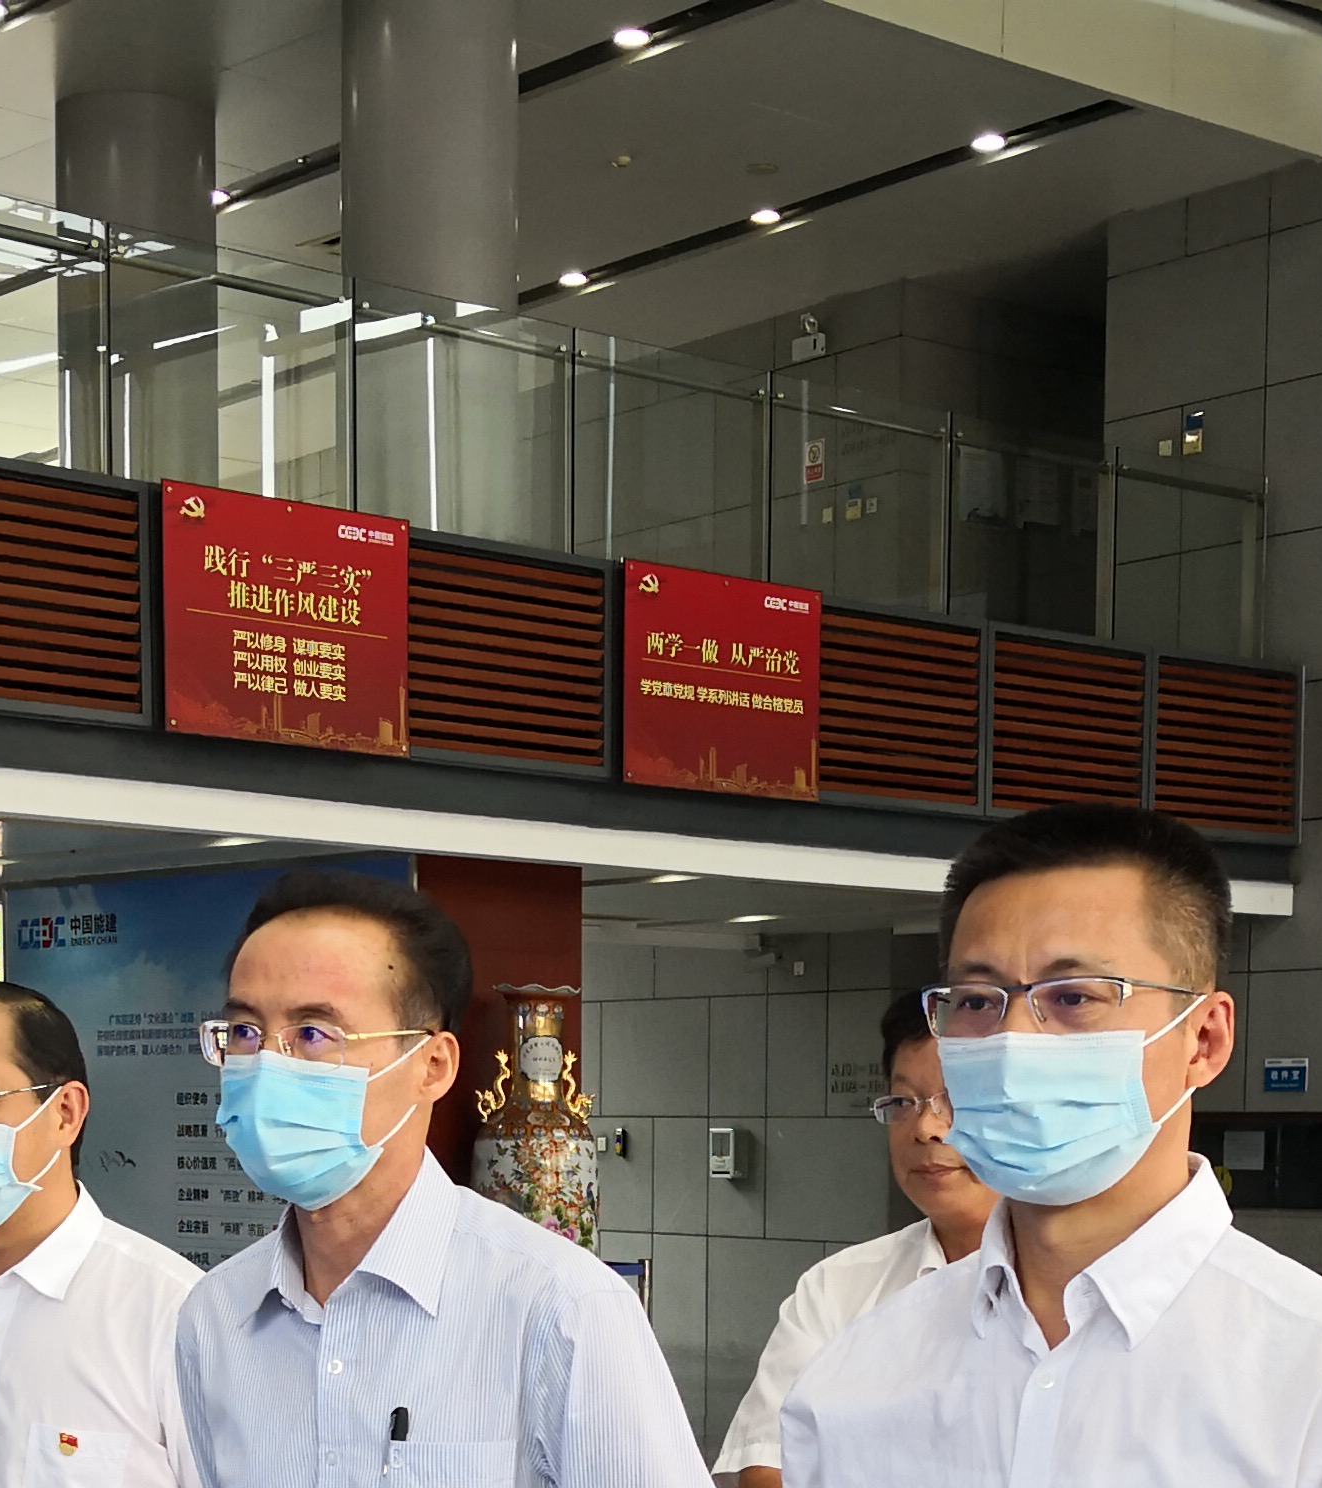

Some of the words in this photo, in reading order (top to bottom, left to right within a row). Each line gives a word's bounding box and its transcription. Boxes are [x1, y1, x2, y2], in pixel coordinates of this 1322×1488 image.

[227, 579, 362, 628] 推进作风建设
[232, 629, 287, 654] 严以修身
[292, 638, 346, 661] 谋事要实
[646, 630, 720, 666] 两学一做
[729, 641, 801, 676] 从严治党
[232, 651, 287, 674] 严以用权
[293, 659, 346, 682] 创业要实
[233, 671, 288, 695] 严以律己
[293, 679, 347, 702] 做人要实
[640, 678, 695, 702] 学党章党规
[697, 686, 750, 709] 学系列讲话
[752, 693, 805, 716] 做合格党员
[70, 912, 117, 936] 中国能建
[177, 1156, 217, 1171] 核心价值观
[177, 1188, 209, 1202] 企业精神
[177, 1219, 209, 1234] 企业宗旨
